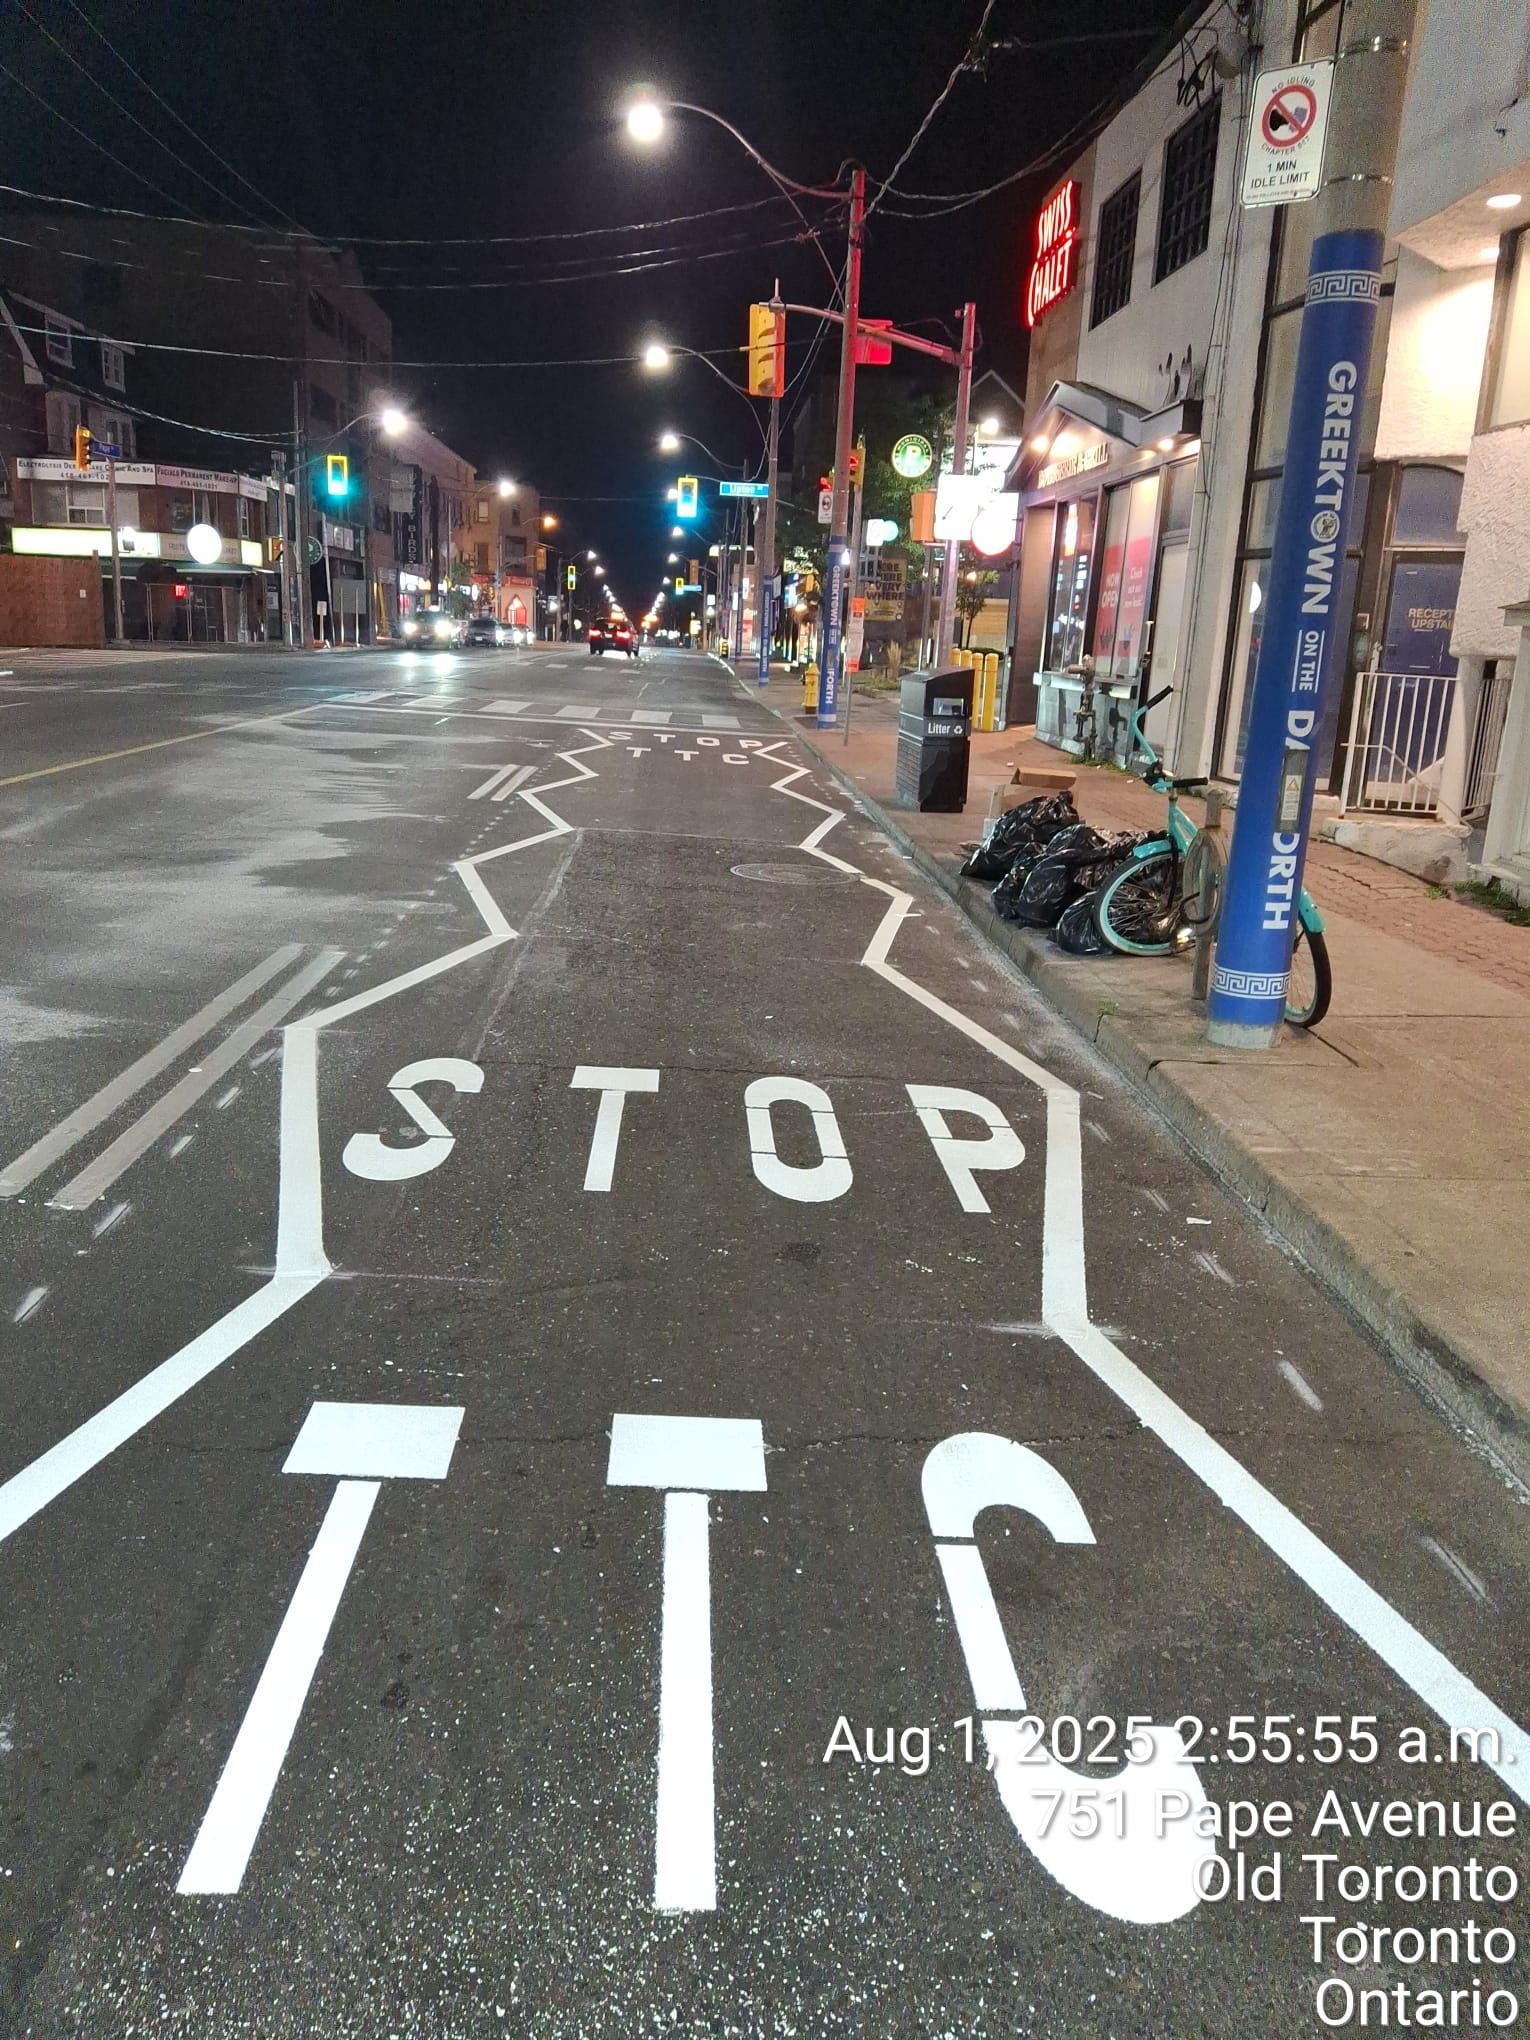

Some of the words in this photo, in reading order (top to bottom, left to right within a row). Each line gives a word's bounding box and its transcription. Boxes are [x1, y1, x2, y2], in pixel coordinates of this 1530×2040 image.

[1271, 81, 1285, 94] NO
[1287, 76, 1315, 88] IDLING
[1261, 143, 1296, 156] CHAPTER
[1267, 163, 1272, 173] 1
[1275, 159, 1297, 172] MIN
[1250, 175, 1277, 189] IDLE
[1279, 171, 1310, 186] LIMIT
[1036, 179, 1073, 259] SWISS
[1027, 238, 1073, 327] CHALET
[181, 469, 213, 481] PERMANENT
[1302, 360, 1357, 614] GREEKTOWN
[866, 591, 905, 601] WHERE
[1101, 590, 1119, 608] OPEN
[1304, 631, 1319, 656] ON
[1299, 660, 1316, 691] THE
[928, 722, 951, 734] Litter
[607, 731, 764, 749] STOP
[626, 746, 750, 765] TTC
[342, 1057, 1027, 1214] STOP
[175, 1401, 1217, 1924] TTC
